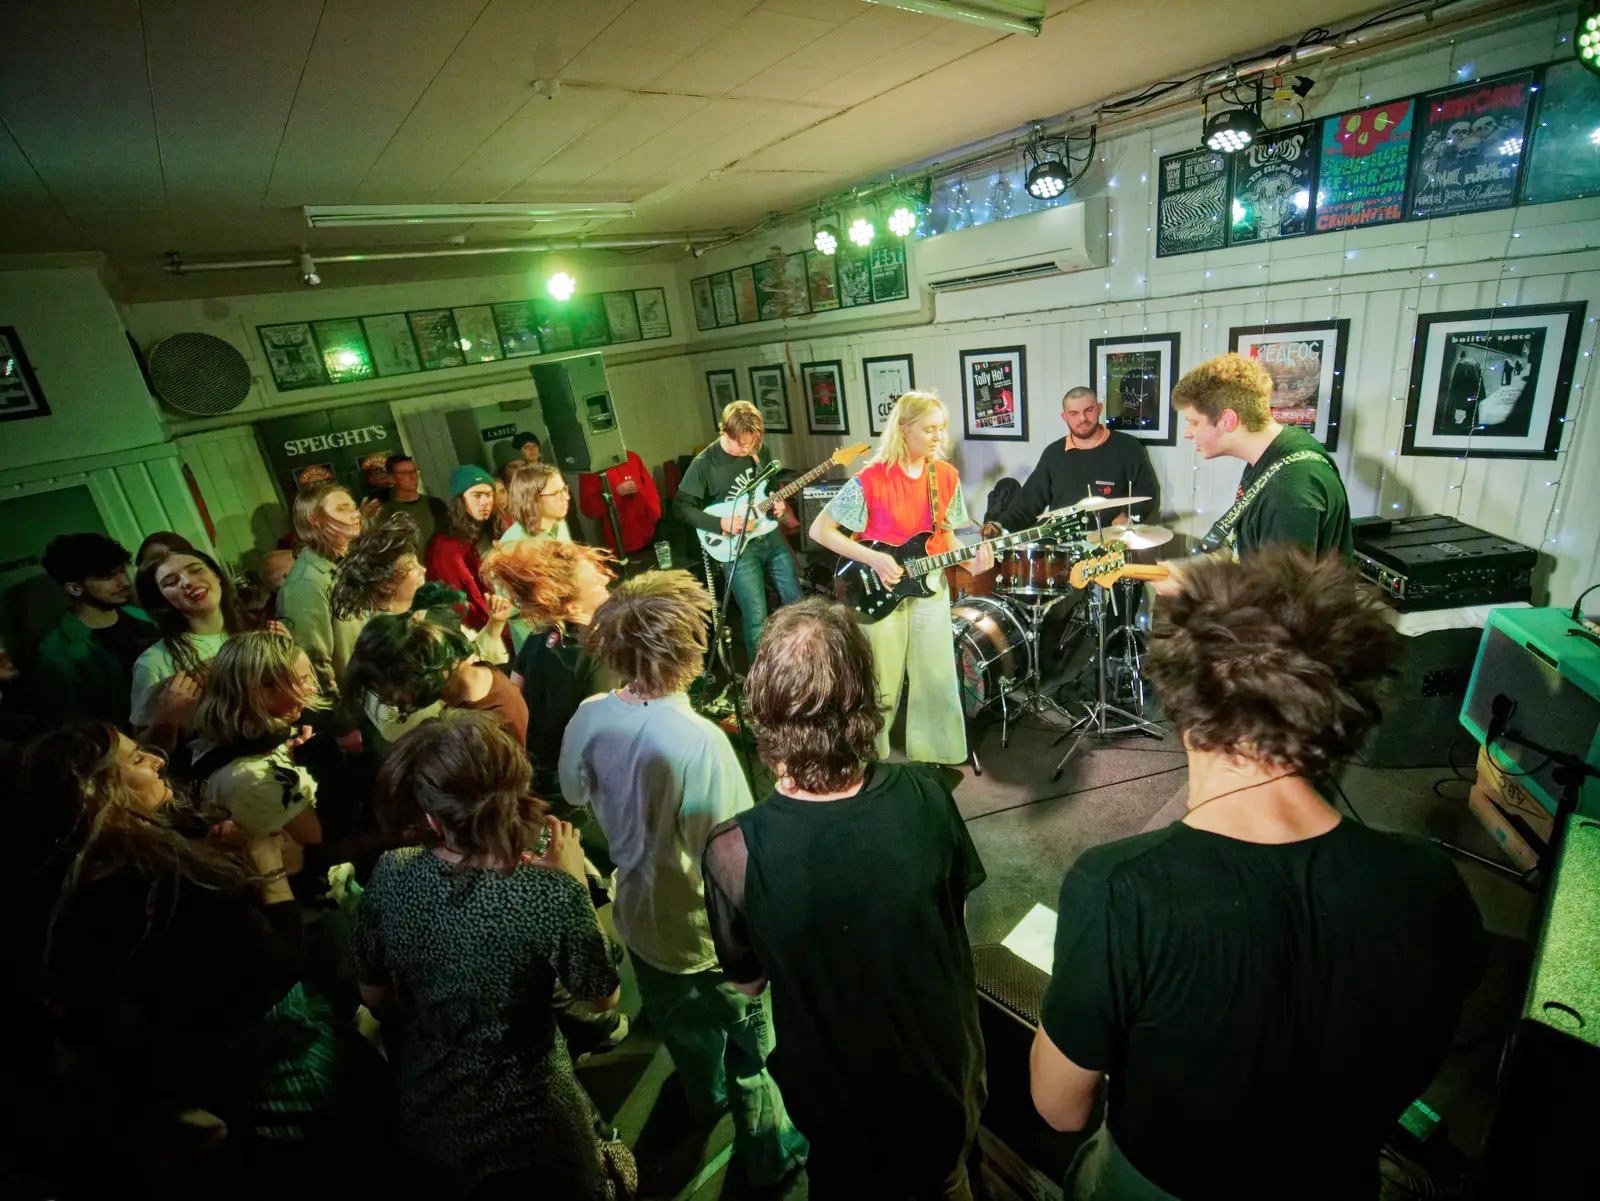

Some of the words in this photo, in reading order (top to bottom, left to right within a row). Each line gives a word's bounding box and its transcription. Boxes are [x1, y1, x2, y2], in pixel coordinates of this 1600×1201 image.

[1497, 333, 1532, 342] space
[991, 367, 1005, 381] Ho!
[284, 425, 387, 456] SPEIGHT'S
